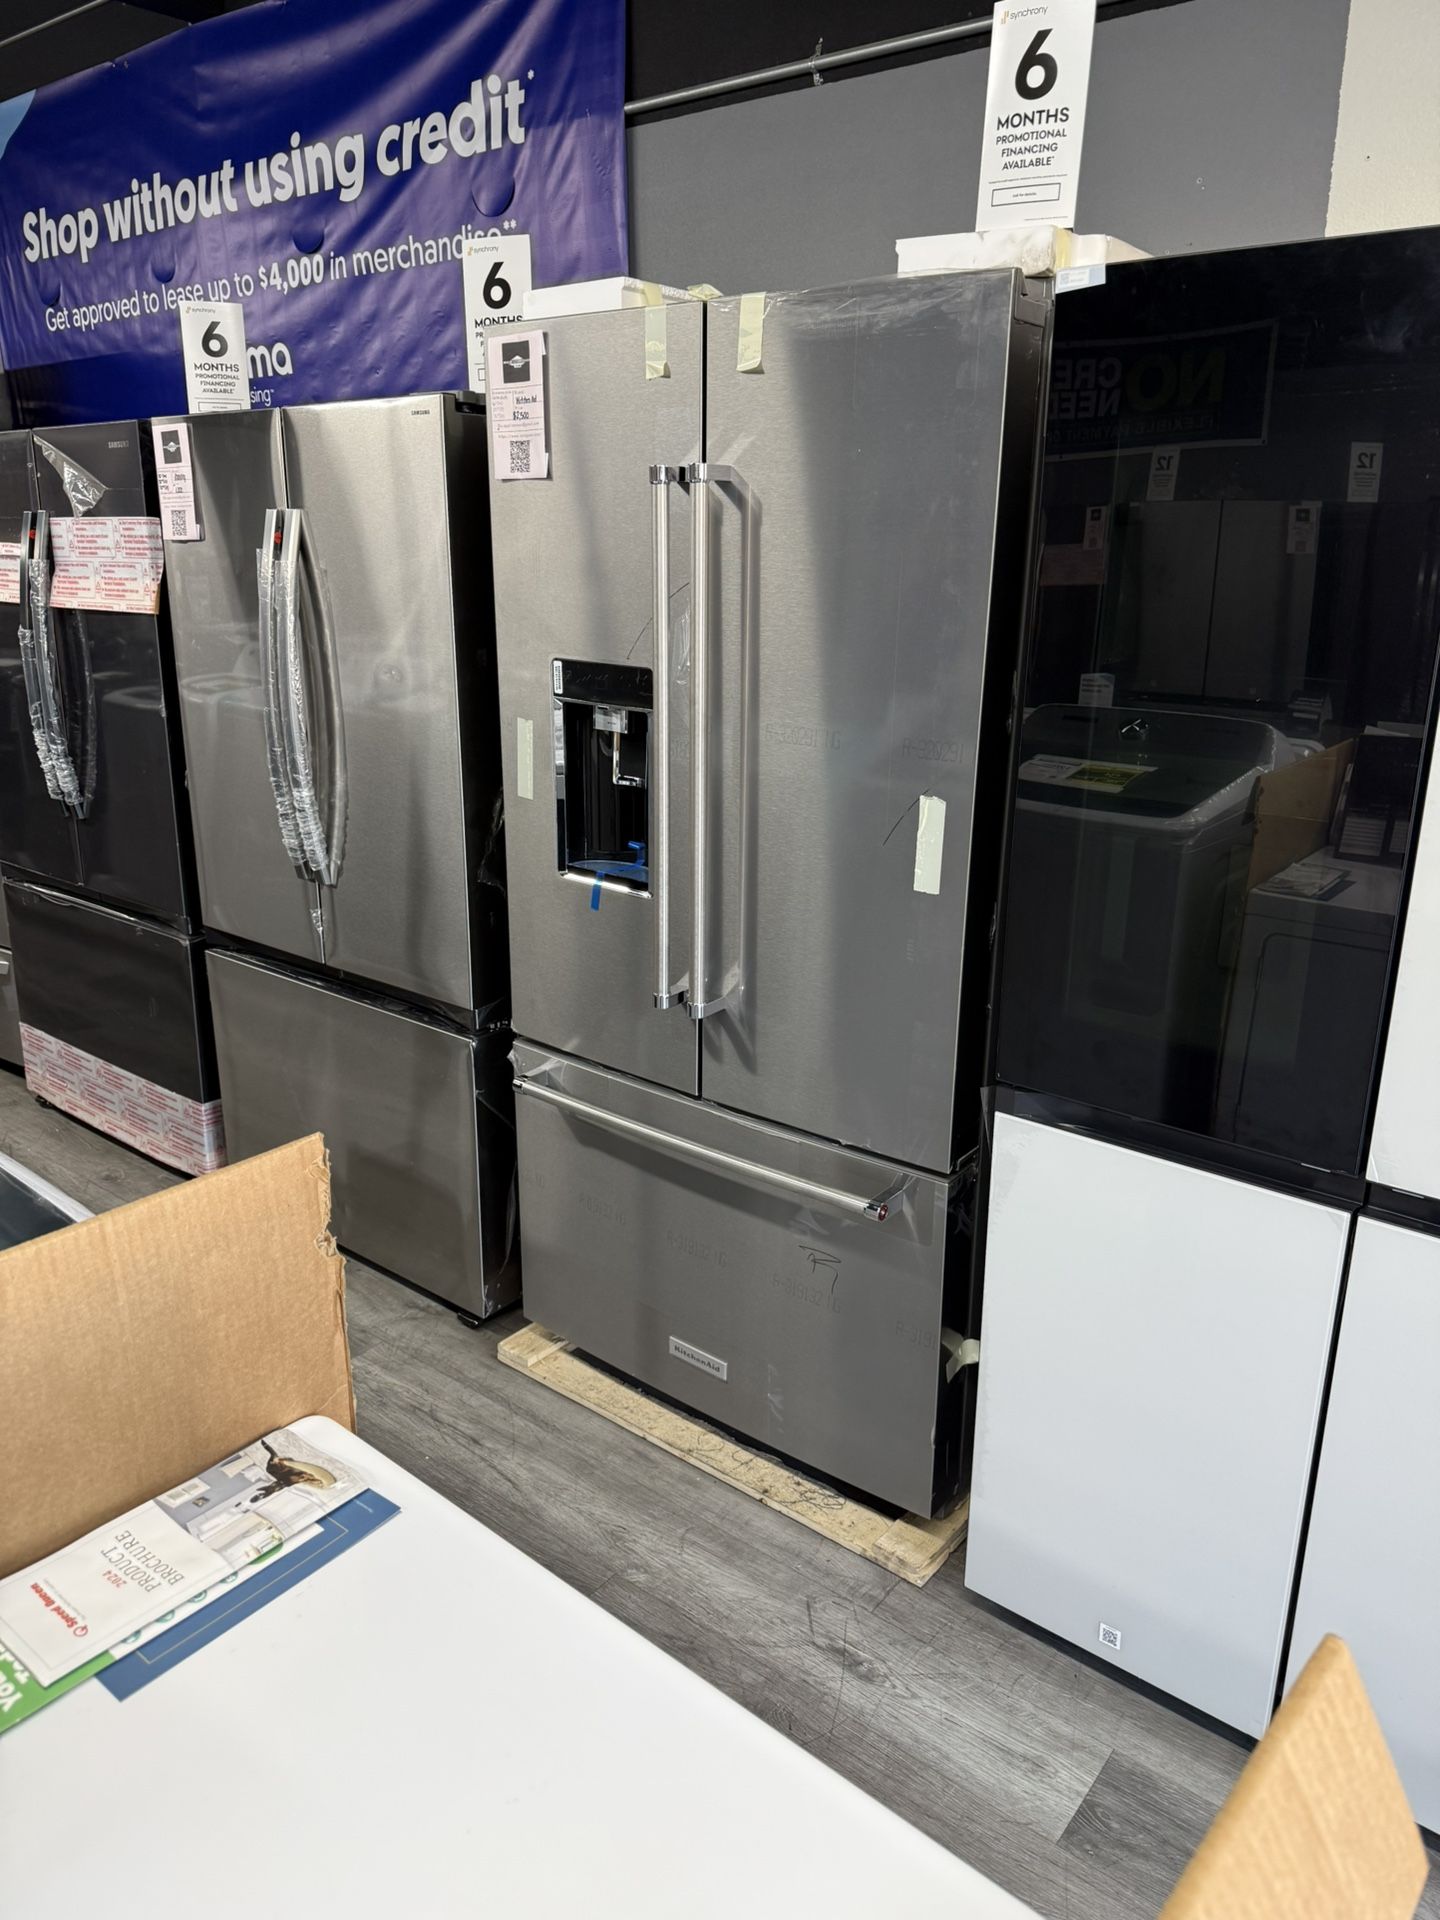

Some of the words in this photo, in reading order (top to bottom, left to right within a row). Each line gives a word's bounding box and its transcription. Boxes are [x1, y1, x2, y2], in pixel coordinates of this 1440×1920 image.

[1009, 6, 1049, 21] synchrony
[1015, 28, 1058, 100] 6
[996, 107, 1070, 131] MONTHS
[995, 128, 1067, 145] PROMOTIONAL
[1001, 142, 1059, 158] FINANCING
[22, 207, 99, 264] Shop
[103, 159, 239, 242] without
[244, 131, 365, 202] using
[45, 307, 71, 332] Get
[72, 290, 141, 332] approved
[142, 290, 160, 313] to
[161, 282, 204, 311] lease
[208, 280, 231, 303] up
[233, 271, 255, 298] to
[258, 254, 325, 295] $4,000
[329, 251, 348, 280] in
[482, 261, 512, 310] 6
[474, 314, 523, 329] MONTHS
[201, 320, 229, 358] 6
[193, 362, 240, 373] MONTHS
[194, 373, 240, 381] PROMOTIONAL
[200, 380, 236, 388] FINANCING
[674, 1344, 721, 1373] KitchenAid
[101, 1546, 162, 1593] PRODUCT
[114, 1530, 185, 1586] BROCHURE
[30, 1582, 56, 1608] Queen
[50, 1605, 80, 1629] Speed
